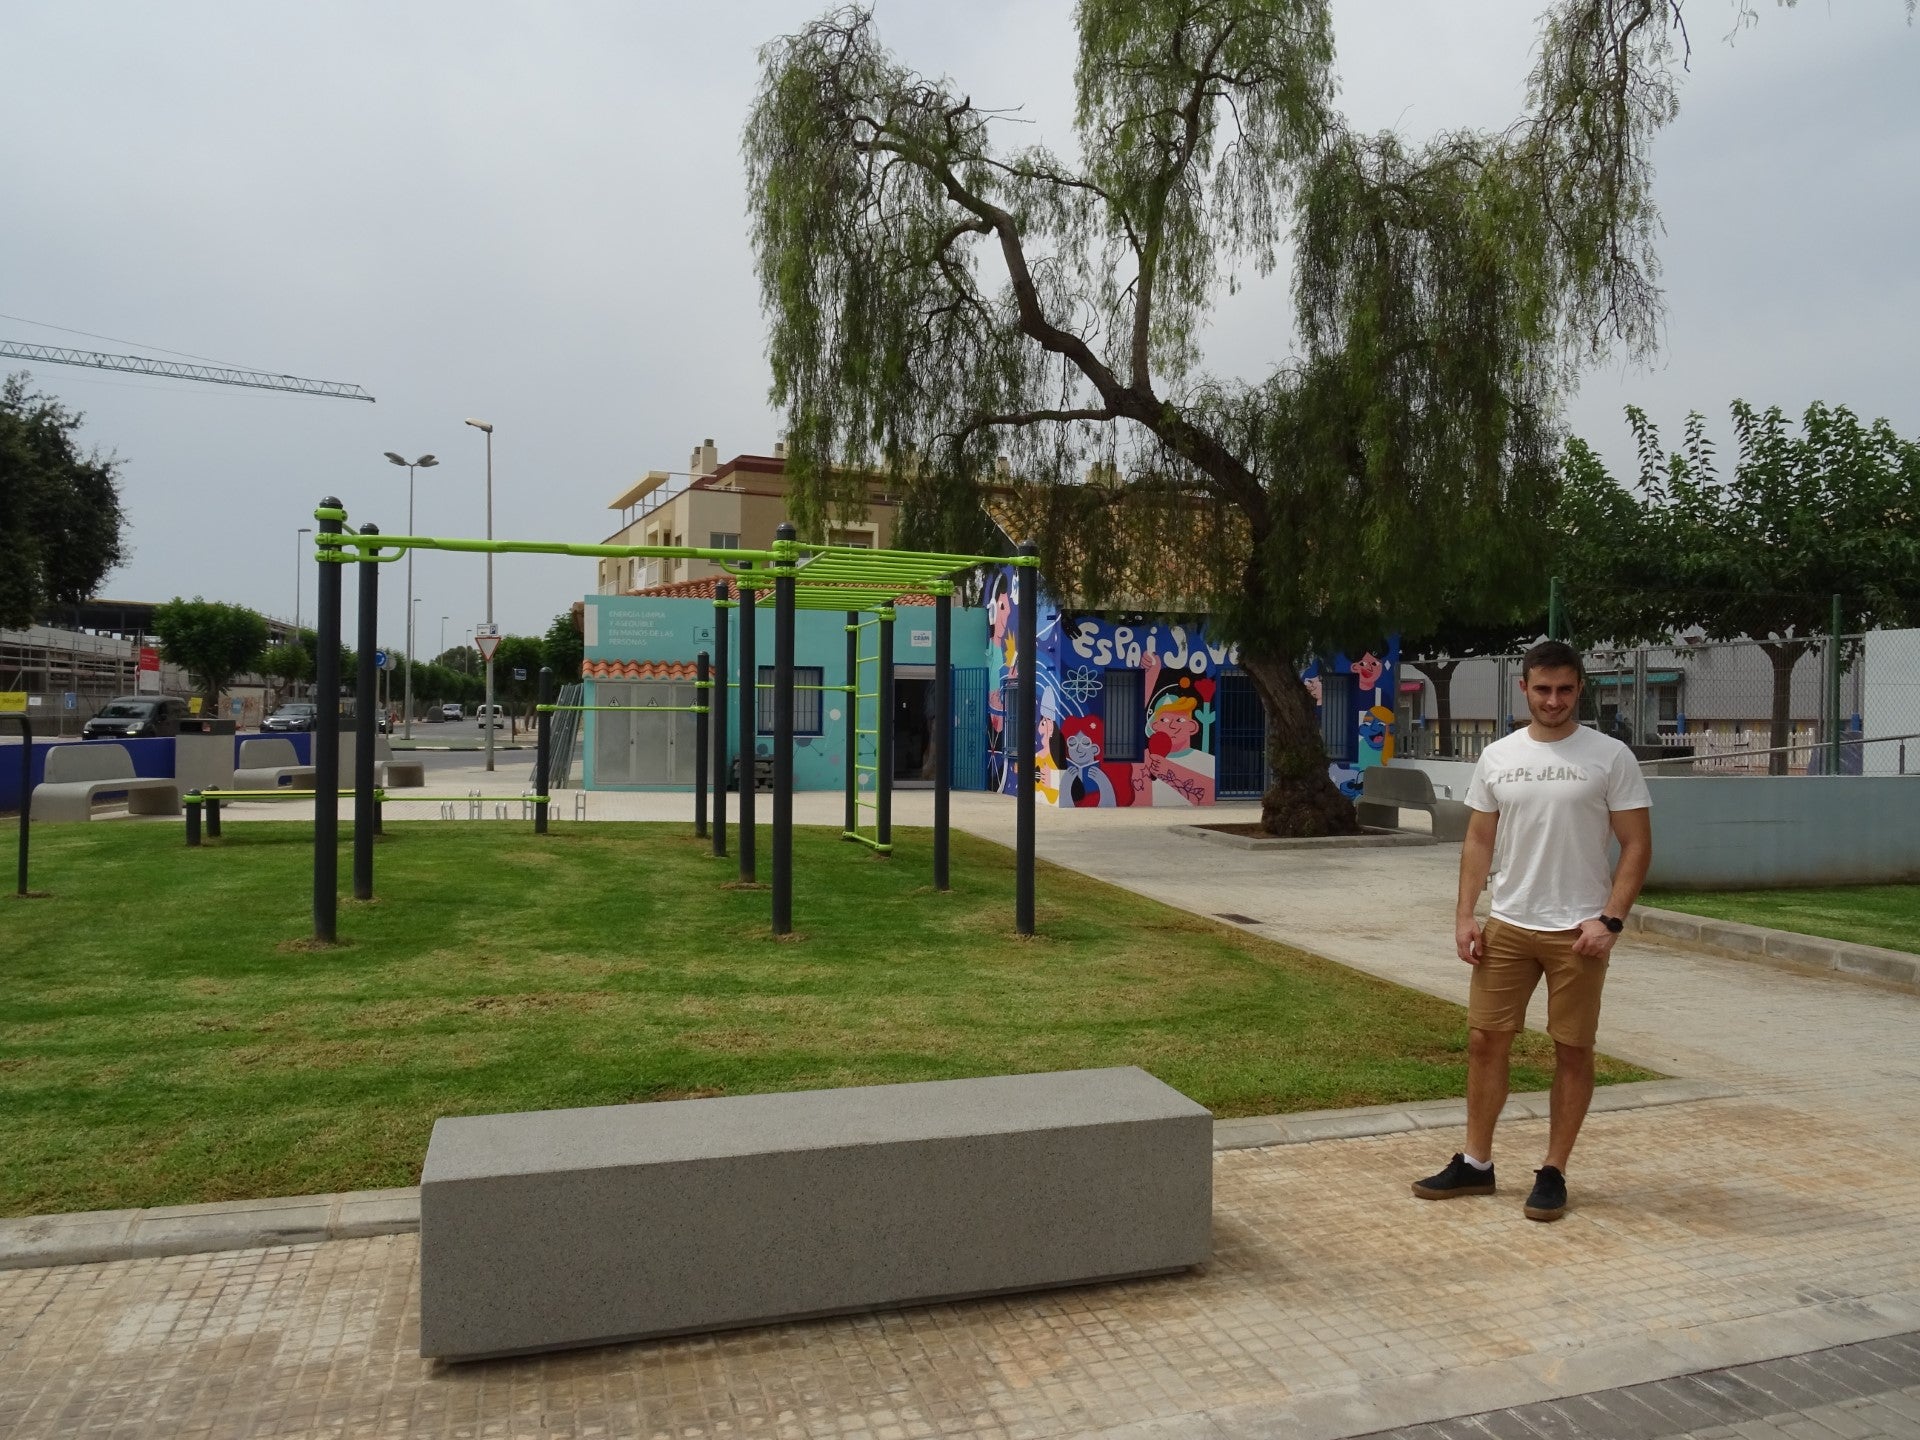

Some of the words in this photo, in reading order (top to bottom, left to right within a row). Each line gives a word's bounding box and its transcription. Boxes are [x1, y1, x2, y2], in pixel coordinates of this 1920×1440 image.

[641, 611, 666, 619] LIMPIA
[1497, 767, 1533, 784] PEPE
[1536, 765, 1588, 782] JEANS
